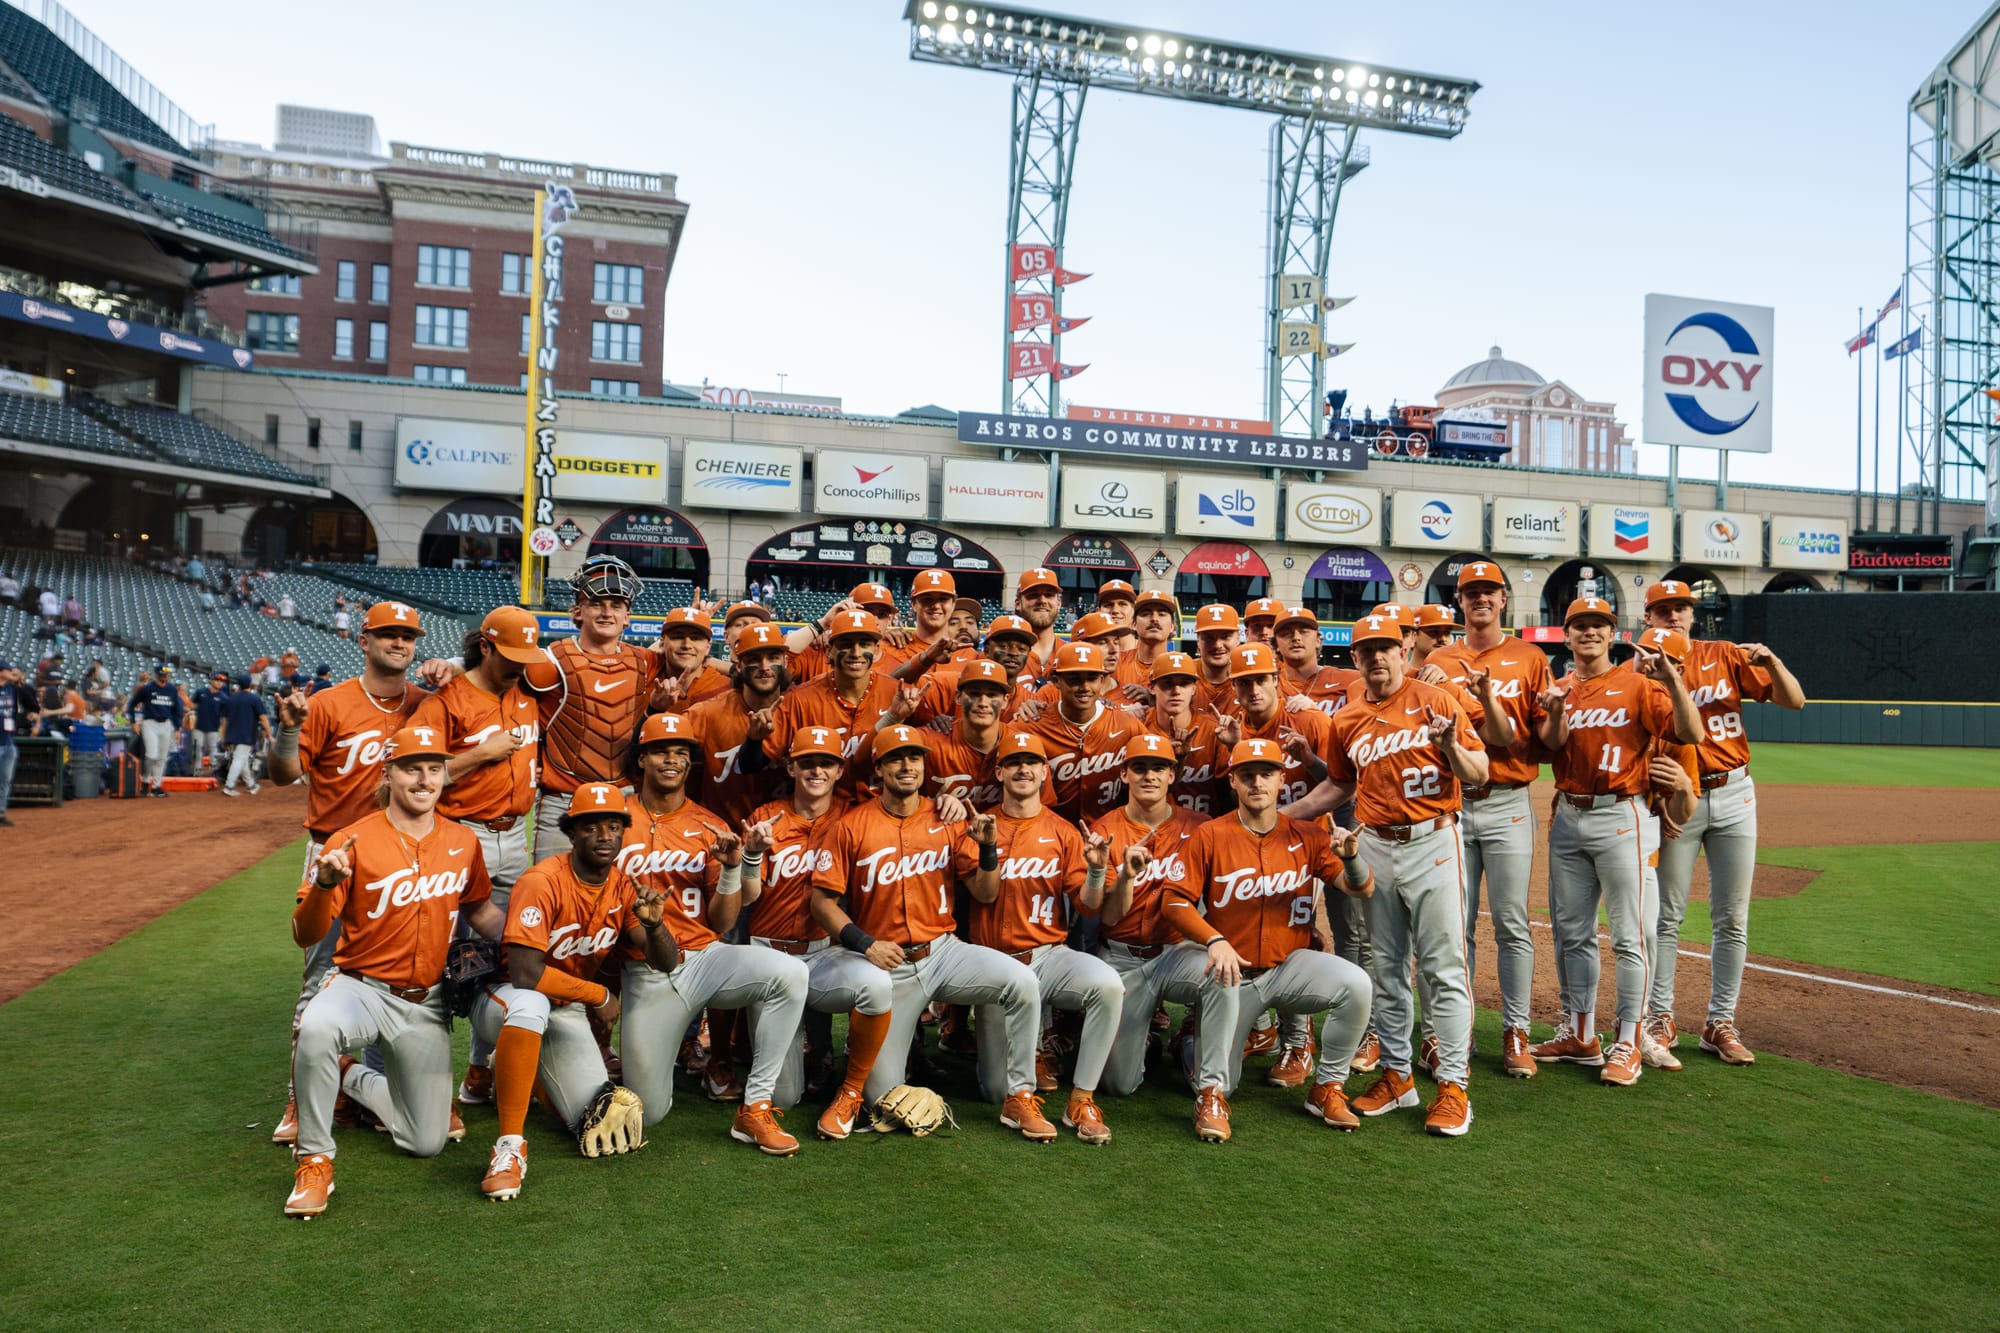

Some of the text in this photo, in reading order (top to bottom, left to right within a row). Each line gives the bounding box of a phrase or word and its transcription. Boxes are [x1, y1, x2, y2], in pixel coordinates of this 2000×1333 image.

[1020, 250, 1047, 271] 05
[1290, 282, 1312, 299] 17
[1021, 301, 1046, 321] 19
[1289, 331, 1310, 347] 22
[1019, 348, 1042, 368] 21
[1661, 354, 1763, 392] OXY
[701, 385, 752, 408] 500
[1092, 408, 1239, 430] DAIKIN PARK
[976, 419, 1353, 462] ASTROS COMMUNITY LEADERS
[435, 446, 513, 466] CALPINE
[557, 457, 657, 476] DOGGETT
[695, 458, 792, 478] CHENIERE
[534, 428, 557, 525] FAIR
[822, 484, 921, 503] ConocoPhillips
[948, 484, 1044, 499] HALLIBURTON
[1221, 488, 1255, 513] slb
[1074, 503, 1153, 520] LEXUS
[1305, 502, 1361, 526] COTTON
[1421, 514, 1452, 526] OXY
[1614, 507, 1650, 519] Chevron
[446, 511, 524, 534] MAVEN
[626, 523, 673, 534] LANDRY'S
[1506, 513, 1560, 533] reliant
[609, 532, 660, 543] CRAWFORD
[662, 535, 690, 545] BOXES
[853, 531, 907, 545] LANDRY'S
[1798, 531, 1841, 555] LNG
[1072, 547, 1112, 557] LANDRY'S
[1703, 548, 1741, 560] QUANTA
[1850, 550, 1952, 568] Budweiser
[1058, 556, 1101, 566] CRAWFORD
[1102, 558, 1126, 567] BOXES
[1197, 560, 1233, 571] equinor
[1327, 555, 1365, 568] planet
[1472, 563, 1488, 577] T
[927, 570, 943, 585] T
[1034, 567, 1048, 580] T
[1332, 565, 1372, 579] fitness
[870, 583, 887, 599] T
[1111, 578, 1125, 589] T
[1661, 579, 1680, 595] T
[1149, 590, 1162, 600] T
[1584, 597, 1600, 609] T
[389, 601, 412, 621] T
[681, 605, 699, 621] T
[1258, 598, 1273, 611] T
[1286, 606, 1303, 618] T
[1384, 605, 1401, 619] T
[1436, 605, 1450, 619] T
[848, 610, 866, 627] T
[1008, 614, 1025, 630] T
[1100, 612, 1114, 625] T
[1208, 606, 1225, 621] T
[631, 622, 662, 634] GEIC
[1365, 614, 1384, 631] T
[523, 626, 537, 643] T
[753, 625, 770, 642] T
[1653, 627, 1671, 643] T
[1074, 646, 1092, 663] T
[1169, 654, 1184, 668] T
[1241, 649, 1258, 666] T
[981, 661, 996, 675] T
[661, 714, 680, 733] T
[1565, 703, 1632, 730] xas
[894, 727, 909, 741] T
[1707, 711, 1743, 742] 99
[413, 727, 434, 746] T
[811, 728, 829, 745] T
[1015, 733, 1030, 747] T
[1143, 735, 1161, 751] T
[1249, 740, 1267, 756] T
[1598, 743, 1622, 773] 11
[1401, 764, 1441, 799] 22
[590, 786, 609, 805] T
[613, 842, 706, 878] Texas
[855, 844, 951, 893] Texas
[996, 848, 1062, 880] xas
[365, 867, 468, 920] Texas
[1213, 864, 1312, 909] Texas
[681, 887, 702, 919] 9
[938, 883, 948, 915] 1
[1028, 893, 1055, 926] 14
[1288, 896, 1312, 928] 15
[448, 910, 460, 944] 7
[546, 922, 619, 960] Texa
